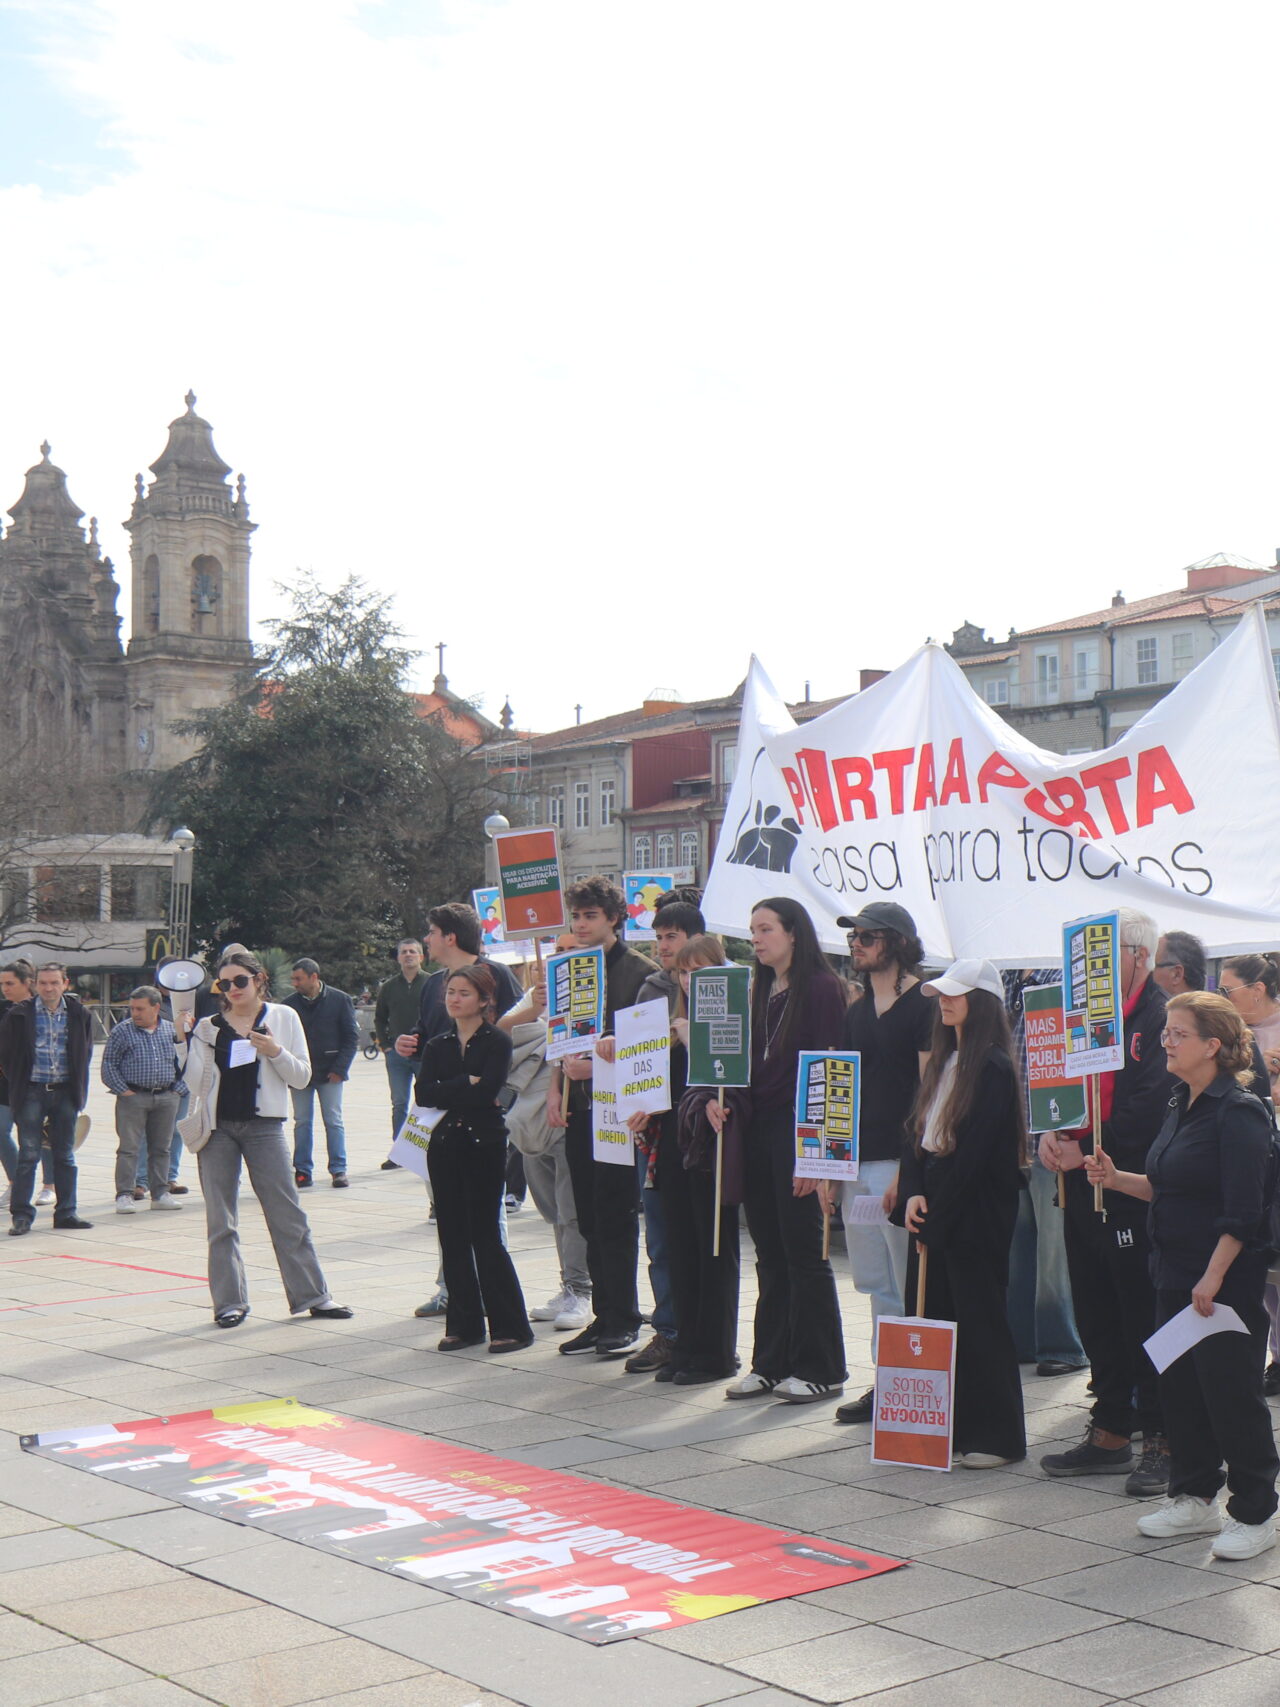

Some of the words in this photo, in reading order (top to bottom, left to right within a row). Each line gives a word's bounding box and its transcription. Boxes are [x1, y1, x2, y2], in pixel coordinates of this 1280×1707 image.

[924, 828, 1001, 900] para
[523, 871, 558, 881] HABITAÇÃO
[698, 984, 725, 997] MAIS
[1027, 1017, 1056, 1036] MAIS
[619, 1036, 667, 1061] CONTROLO
[634, 1058, 653, 1076] DAS
[625, 1075, 663, 1097] RENDAS
[599, 1128, 626, 1146] DIREITO
[893, 1377, 933, 1394] SOLOS
[884, 1391, 910, 1407] DOS
[913, 1394, 931, 1409] LEI
[934, 1395, 943, 1410] A
[880, 1407, 946, 1425] REVOGAR
[349, 1471, 533, 1521] HABITAÇÃO
[485, 1510, 583, 1535] EM
[536, 1524, 743, 1583] PORTUGAL
